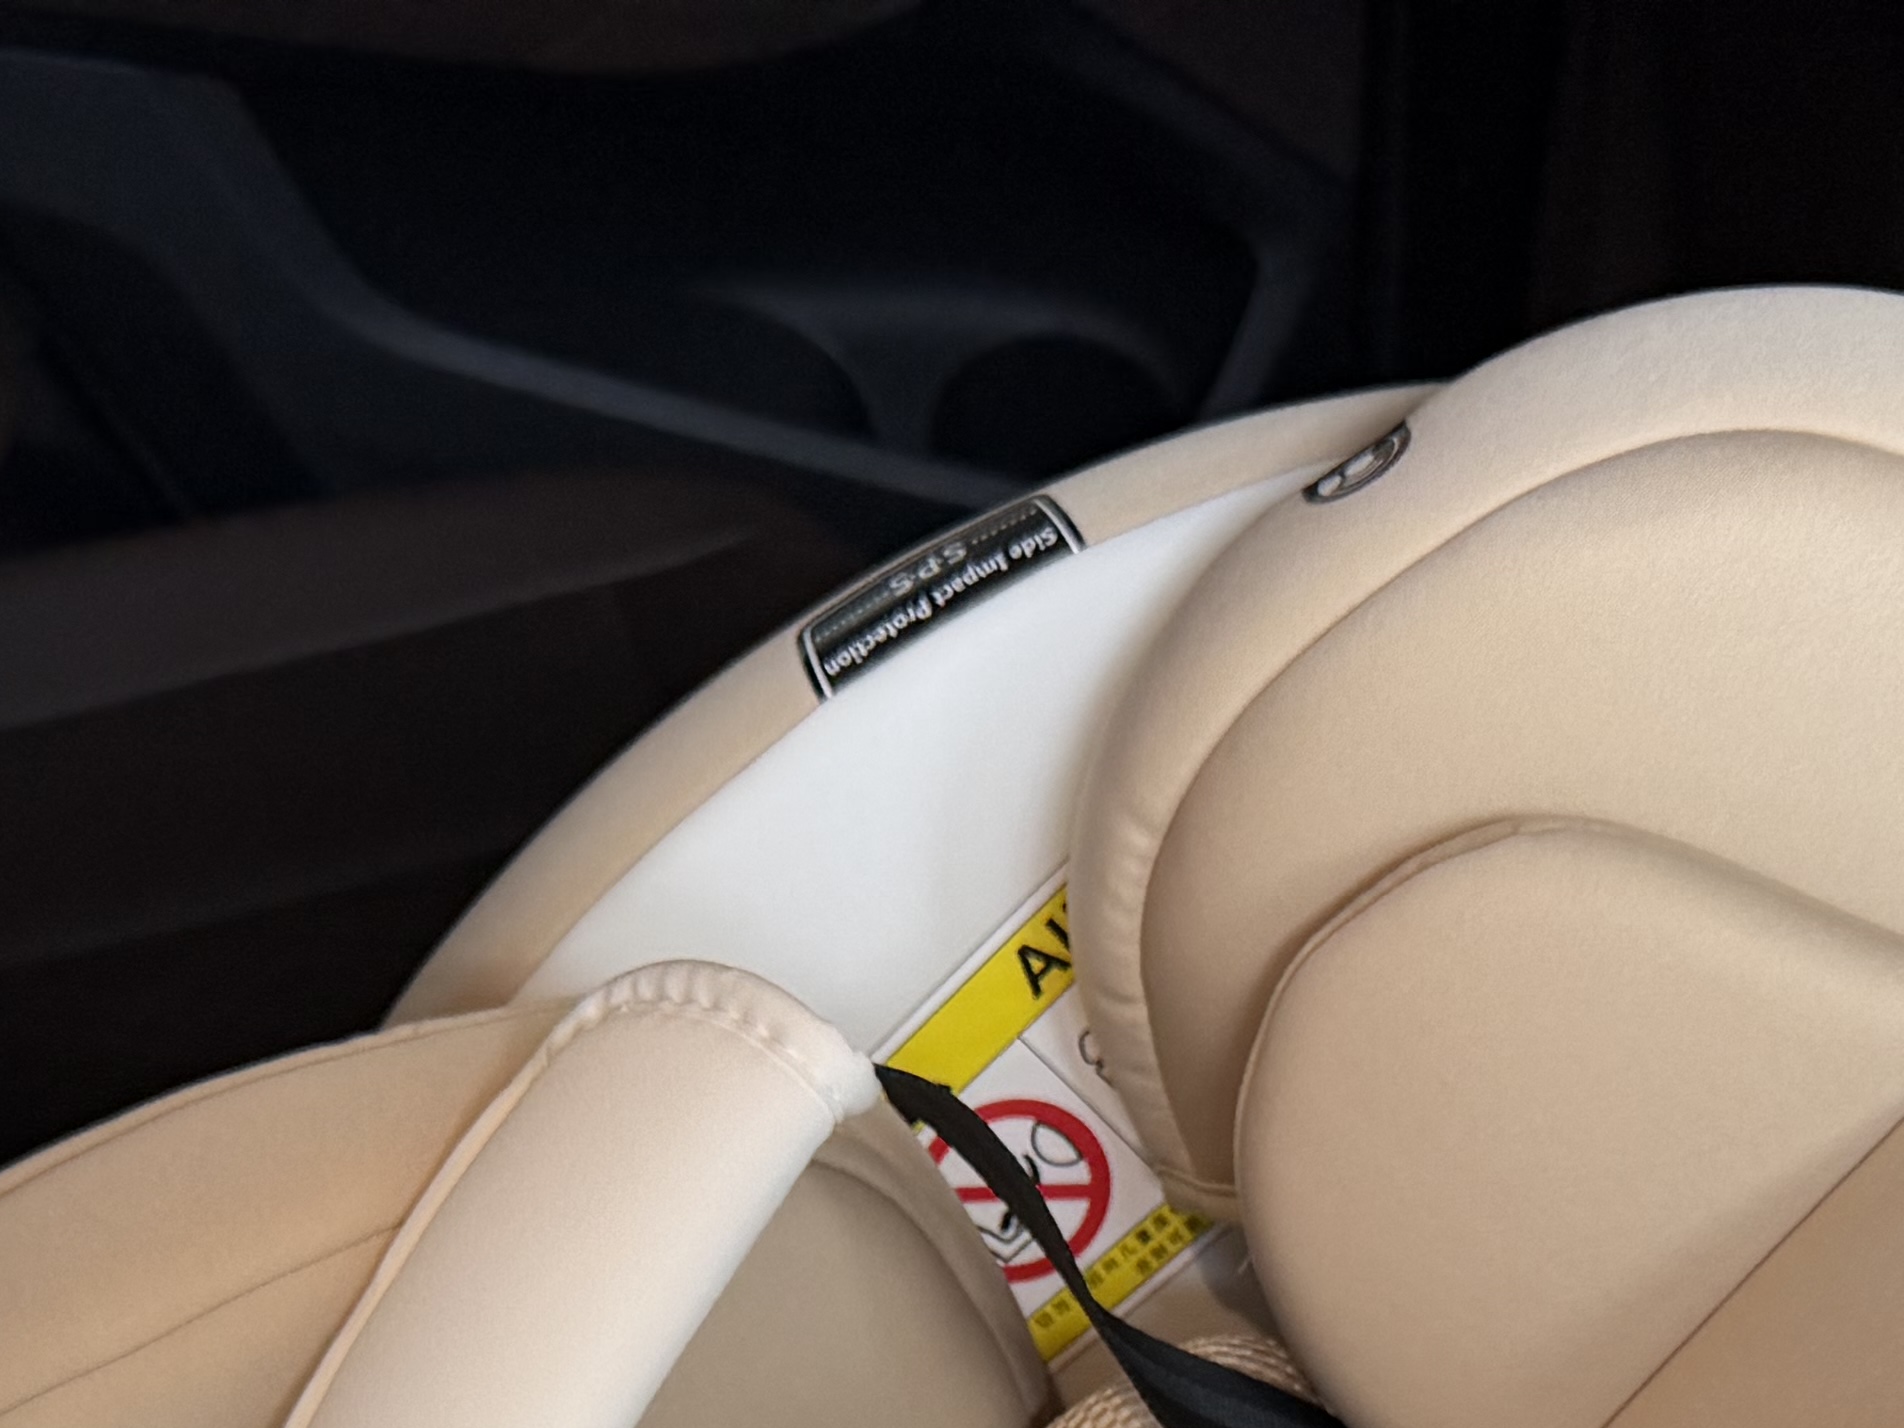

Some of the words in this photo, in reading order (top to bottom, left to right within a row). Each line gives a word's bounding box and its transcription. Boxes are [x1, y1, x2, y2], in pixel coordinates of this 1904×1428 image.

[1008, 527, 1059, 561] Side
[929, 556, 1010, 611] Impact
[824, 598, 931, 679] Protection
